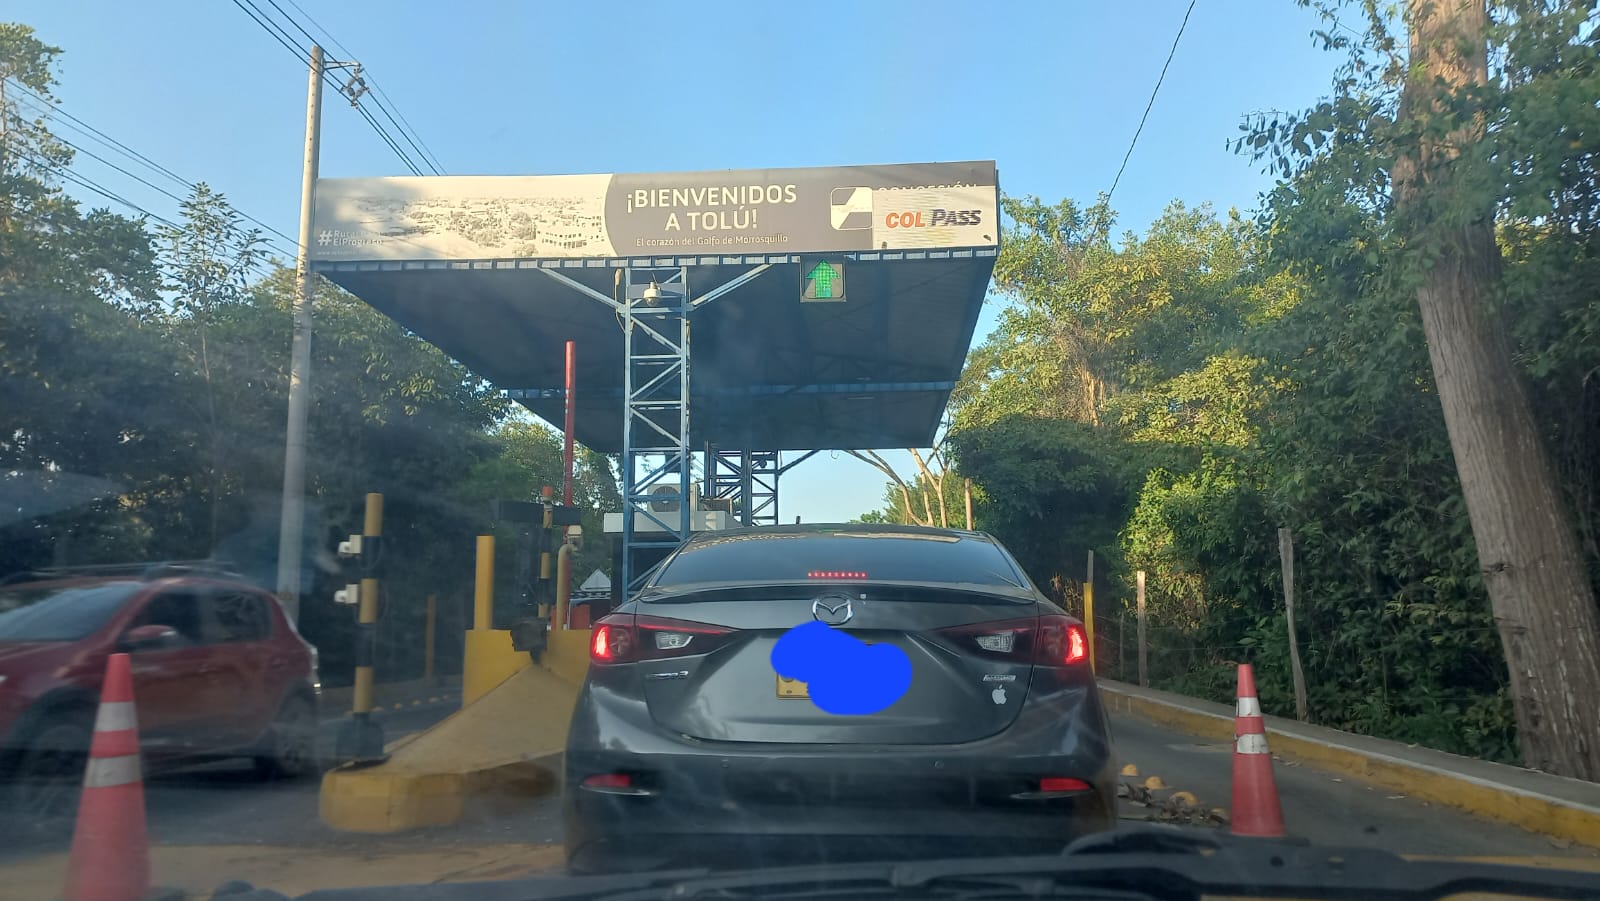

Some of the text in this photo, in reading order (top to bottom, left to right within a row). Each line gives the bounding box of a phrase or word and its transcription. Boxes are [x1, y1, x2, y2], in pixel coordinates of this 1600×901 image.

[627, 184, 797, 213] ¡BIENVENIDOS
[665, 205, 757, 231] A TOLÚ!
[885, 211, 926, 229] COL
[636, 238, 645, 247] El
[646, 236, 680, 247] corazón
[681, 236, 695, 246] del
[697, 235, 720, 247] Golfo
[722, 235, 733, 245] de
